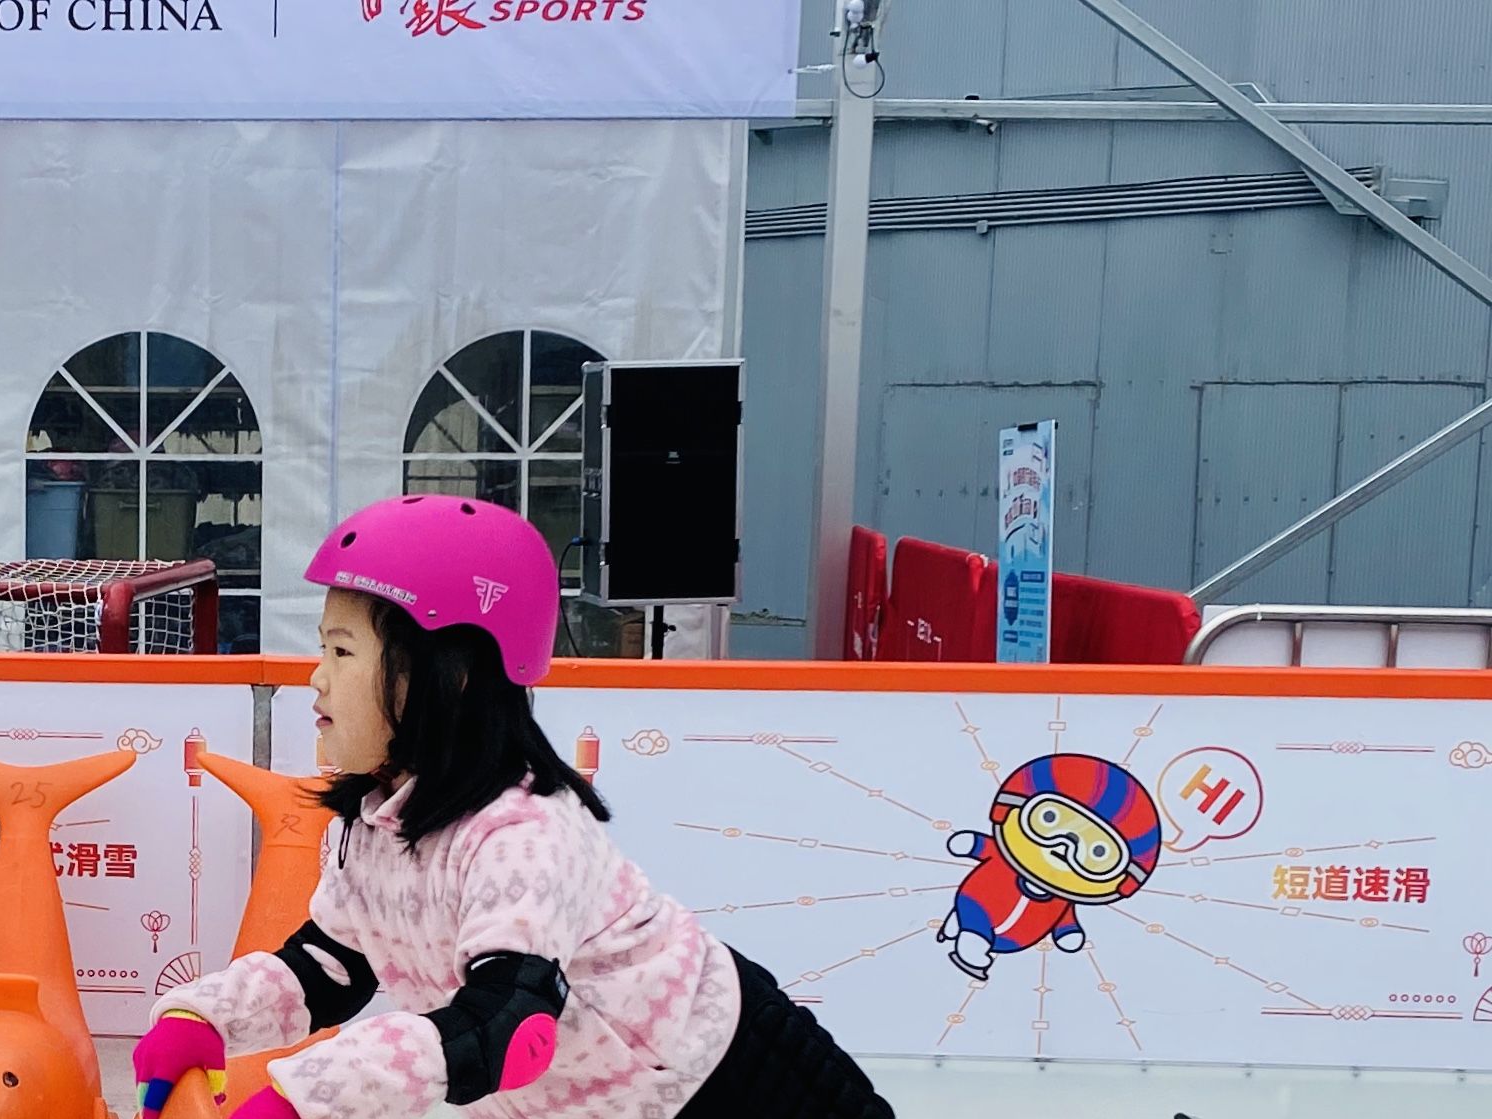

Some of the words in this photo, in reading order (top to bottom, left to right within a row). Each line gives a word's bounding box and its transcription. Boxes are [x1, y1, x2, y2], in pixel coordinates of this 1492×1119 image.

[67, 0, 222, 31] CHINA
[489, 0, 647, 22] SPORTS
[9, 781, 54, 809] 25
[1179, 764, 1246, 826] HI
[1270, 863, 1431, 904] 短道速滑
